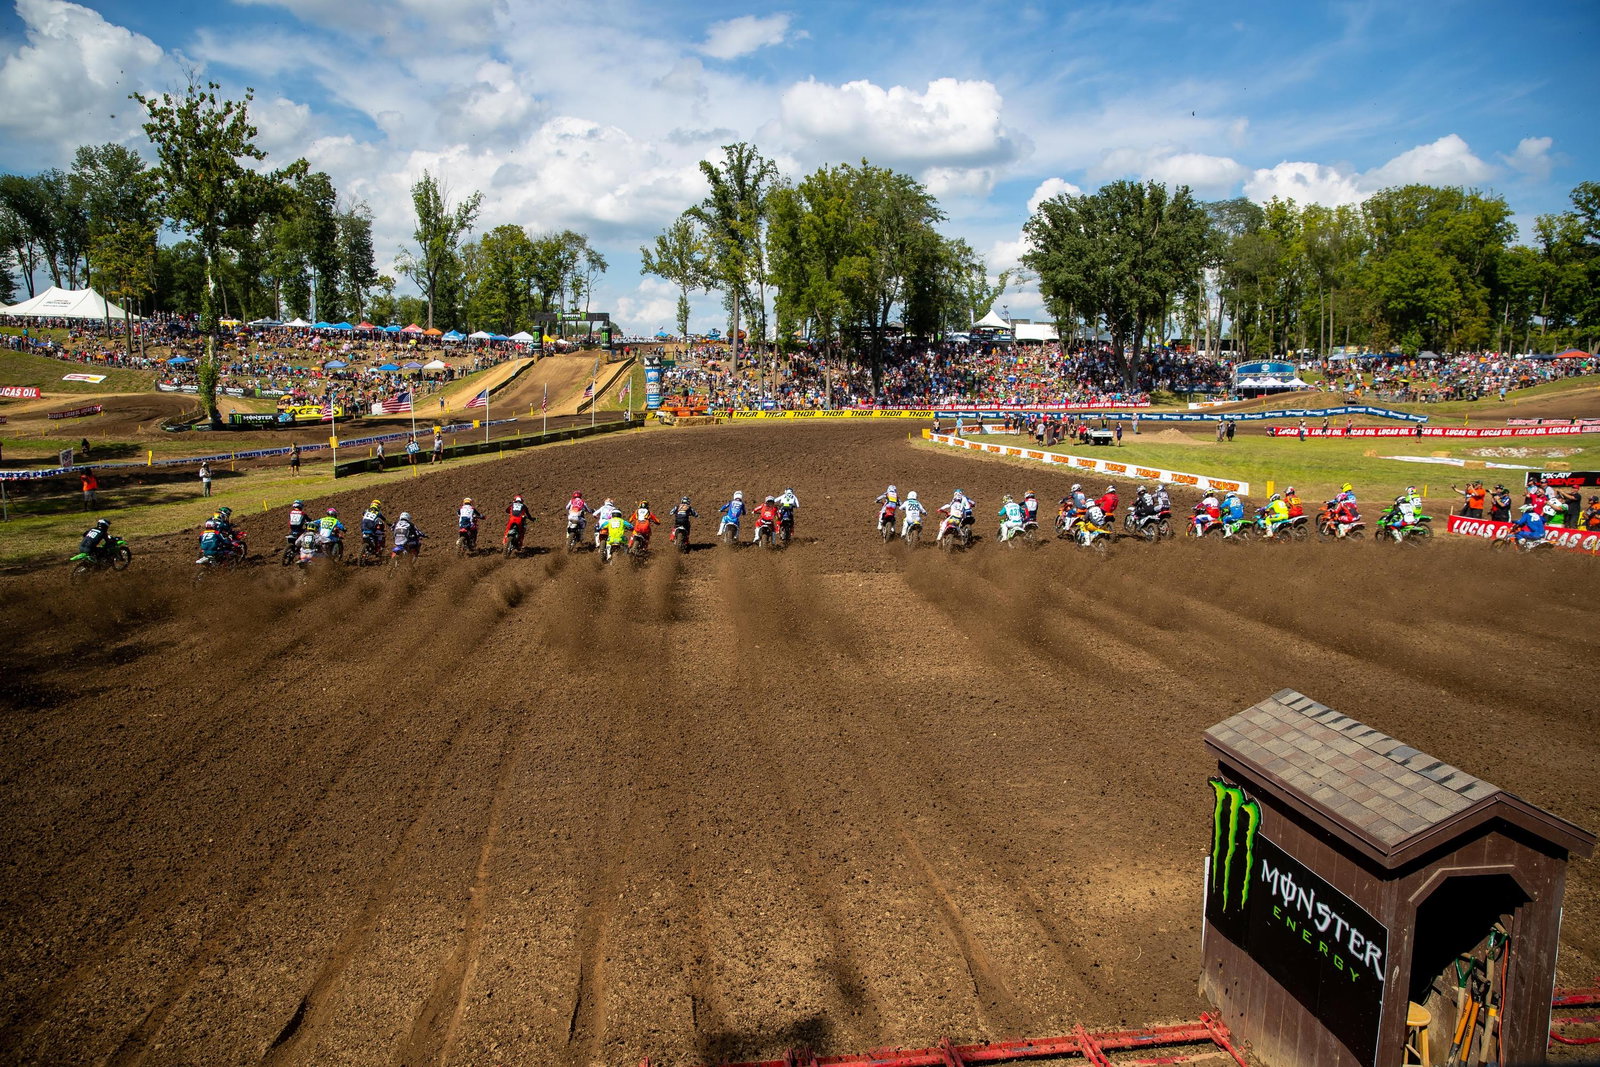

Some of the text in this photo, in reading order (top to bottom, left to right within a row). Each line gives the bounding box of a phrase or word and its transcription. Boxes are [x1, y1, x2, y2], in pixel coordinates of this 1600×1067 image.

[0, 388, 37, 397] UCAS OIL
[1453, 520, 1495, 538] LUCAS
[1261, 859, 1384, 980] MONSTER
[1273, 905, 1359, 982] ENERGY
